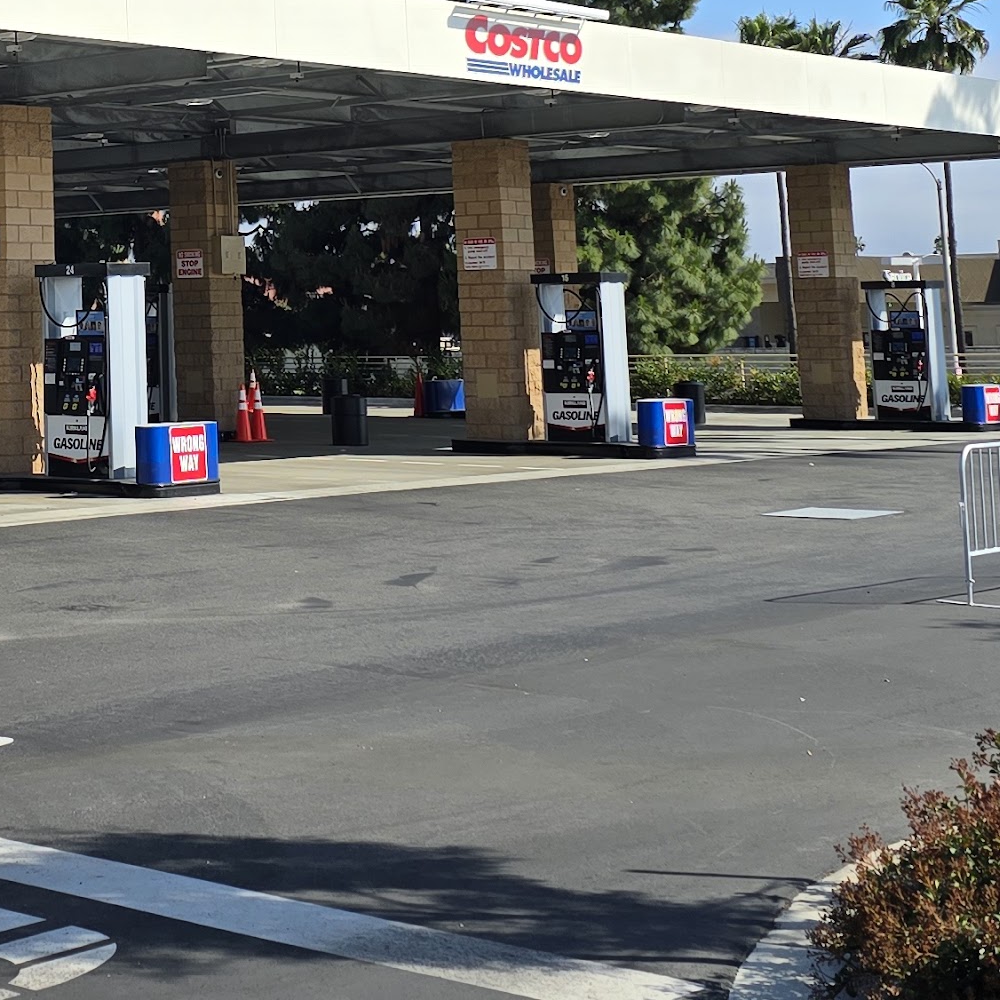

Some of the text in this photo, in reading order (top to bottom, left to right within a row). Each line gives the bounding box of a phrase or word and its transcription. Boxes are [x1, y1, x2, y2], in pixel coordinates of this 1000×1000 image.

[465, 15, 582, 64] COSTCO
[509, 63, 581, 83] WHOLESALE
[65, 265, 75, 275] 24
[178, 268, 202, 276] ENGINE
[53, 437, 104, 451] GASOLNE
[171, 434, 205, 454] WRONG
[179, 454, 199, 473] WAY
